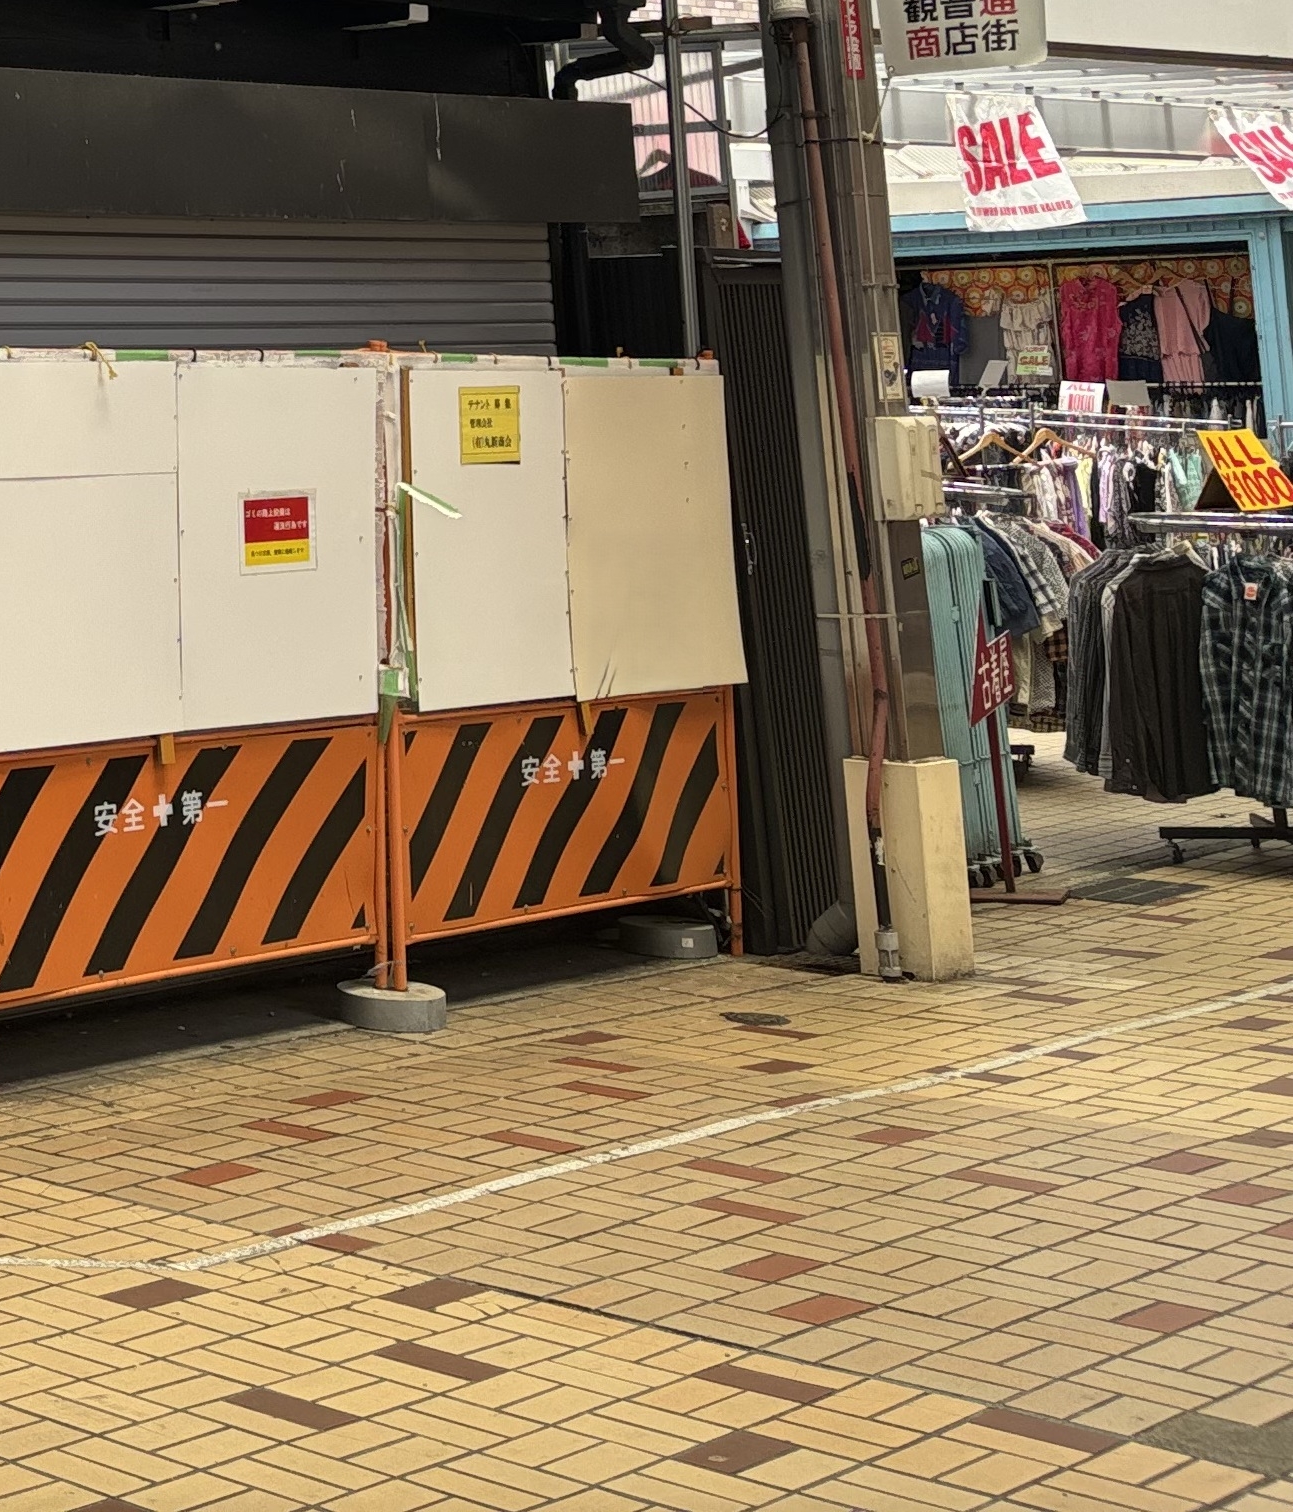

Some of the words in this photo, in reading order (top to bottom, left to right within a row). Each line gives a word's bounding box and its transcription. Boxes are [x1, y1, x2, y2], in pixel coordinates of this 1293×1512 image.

[905, 18, 1020, 61] 商店街
[957, 111, 1063, 197] SALE
[1066, 383, 1096, 393] ALL
[1206, 434, 1267, 470] ALL
[1221, 467, 1293, 508] ¥1000
[977, 636, 1014, 710] 古着屋
